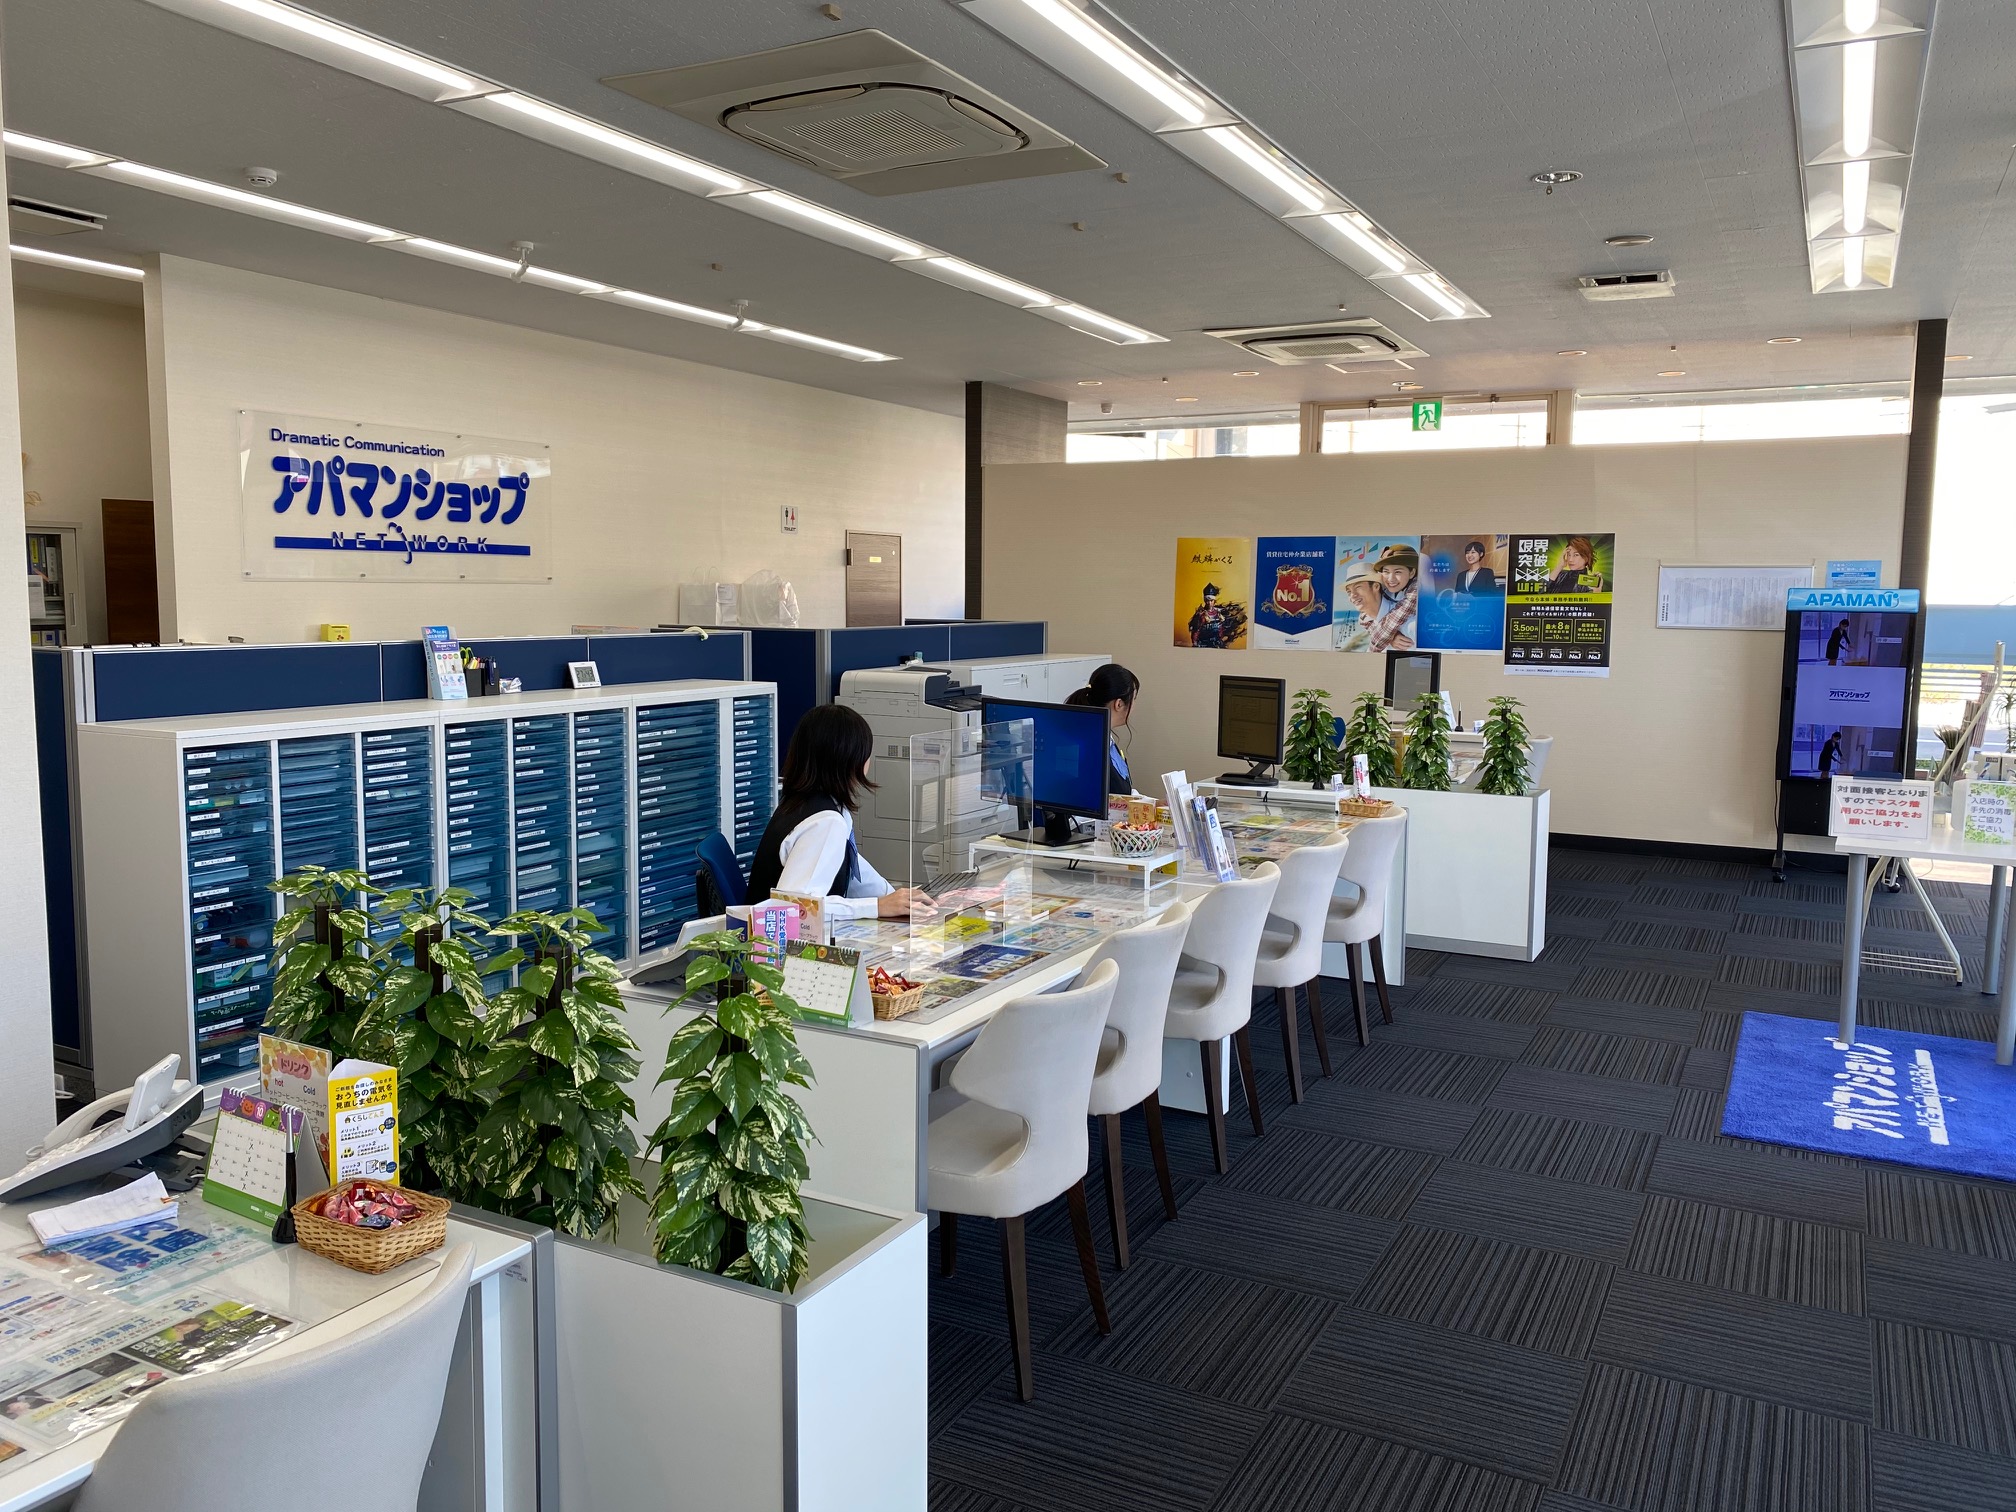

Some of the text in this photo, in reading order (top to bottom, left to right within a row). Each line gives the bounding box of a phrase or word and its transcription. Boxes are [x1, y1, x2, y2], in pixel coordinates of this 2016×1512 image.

[270, 428, 445, 458] Dramatic Communication
[272, 455, 530, 525] アパマンショップ
[332, 531, 488, 552] NETWORK
[1518, 539, 1549, 553] 限界
[1518, 554, 1548, 567] 突破
[1276, 579, 1310, 602] No.1
[1517, 582, 1547, 592] WiFi
[1804, 593, 1893, 607] APAMAN
[1837, 785, 1928, 797] 対面接客となりま
[1842, 796, 1920, 808] すのでマスク着
[1840, 806, 1922, 819] 用のご協力をお
[1848, 818, 1910, 830] 願いします。
[280, 1058, 309, 1075] ドリンク
[274, 1078, 284, 1087] hot
[302, 1085, 316, 1096] Cold
[335, 1083, 392, 1101] おうちの電気を
[335, 1092, 393, 1110] 見直しませんか？
[256, 1105, 264, 1118] 10
[352, 1110, 385, 1123] くらしでんき
